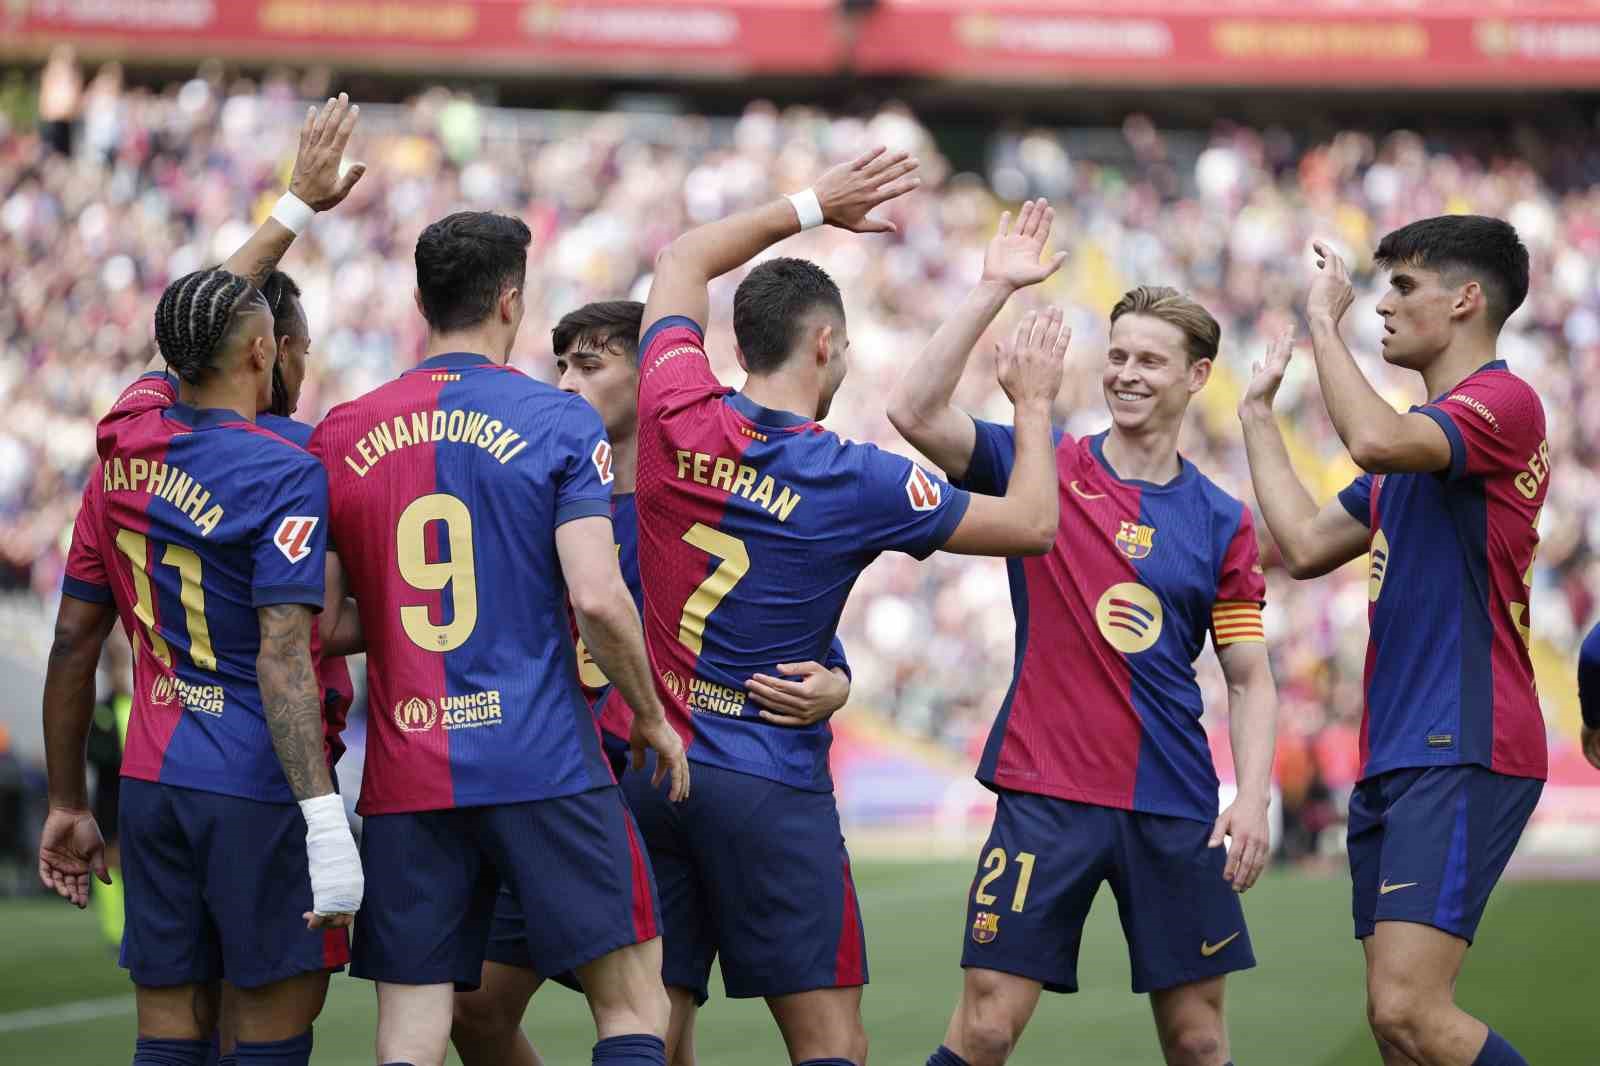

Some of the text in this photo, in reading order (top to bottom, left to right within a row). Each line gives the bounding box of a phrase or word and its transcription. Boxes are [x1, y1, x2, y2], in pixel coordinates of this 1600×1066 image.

[344, 409, 528, 477] LEWANDOWSKI
[676, 449, 801, 522] FERRAN
[115, 528, 217, 672] 11
[396, 493, 478, 652] 9
[678, 522, 750, 656] 7
[440, 690, 500, 710] UNHCR
[441, 704, 502, 724] ACNUR
[687, 692, 743, 716] ACNUR
[689, 678, 746, 705] UNHCR
[975, 847, 1036, 912] 21
